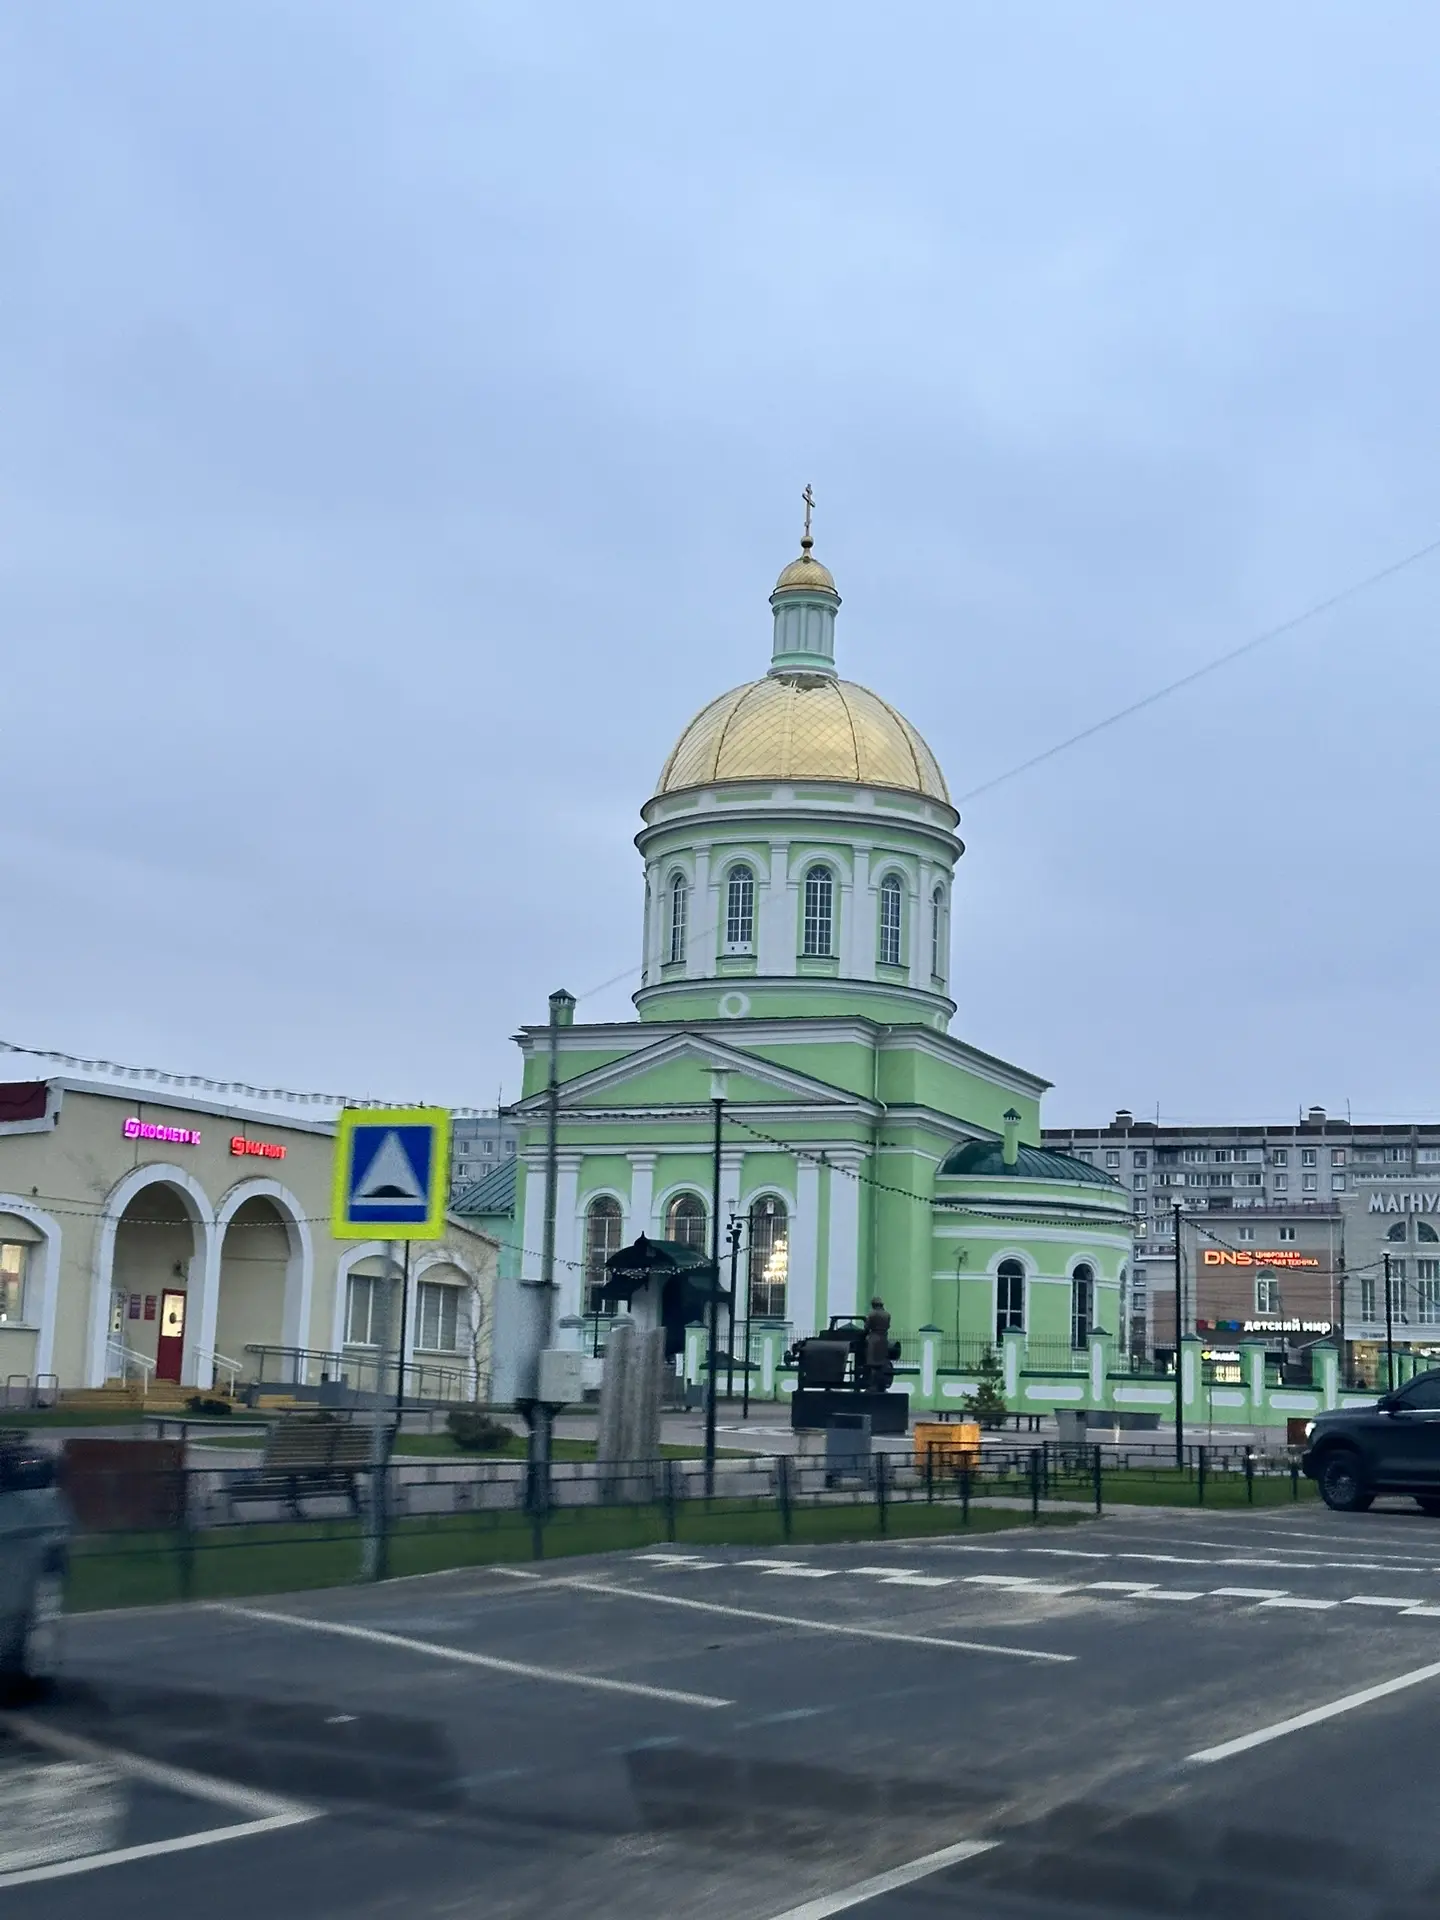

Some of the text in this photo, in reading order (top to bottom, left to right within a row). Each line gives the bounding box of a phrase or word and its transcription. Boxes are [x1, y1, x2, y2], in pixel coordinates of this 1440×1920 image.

[1367, 1192, 1440, 1213] МАГНУ
[1204, 1251, 1252, 1265] DNS
[1243, 1318, 1331, 1334] детский мир
